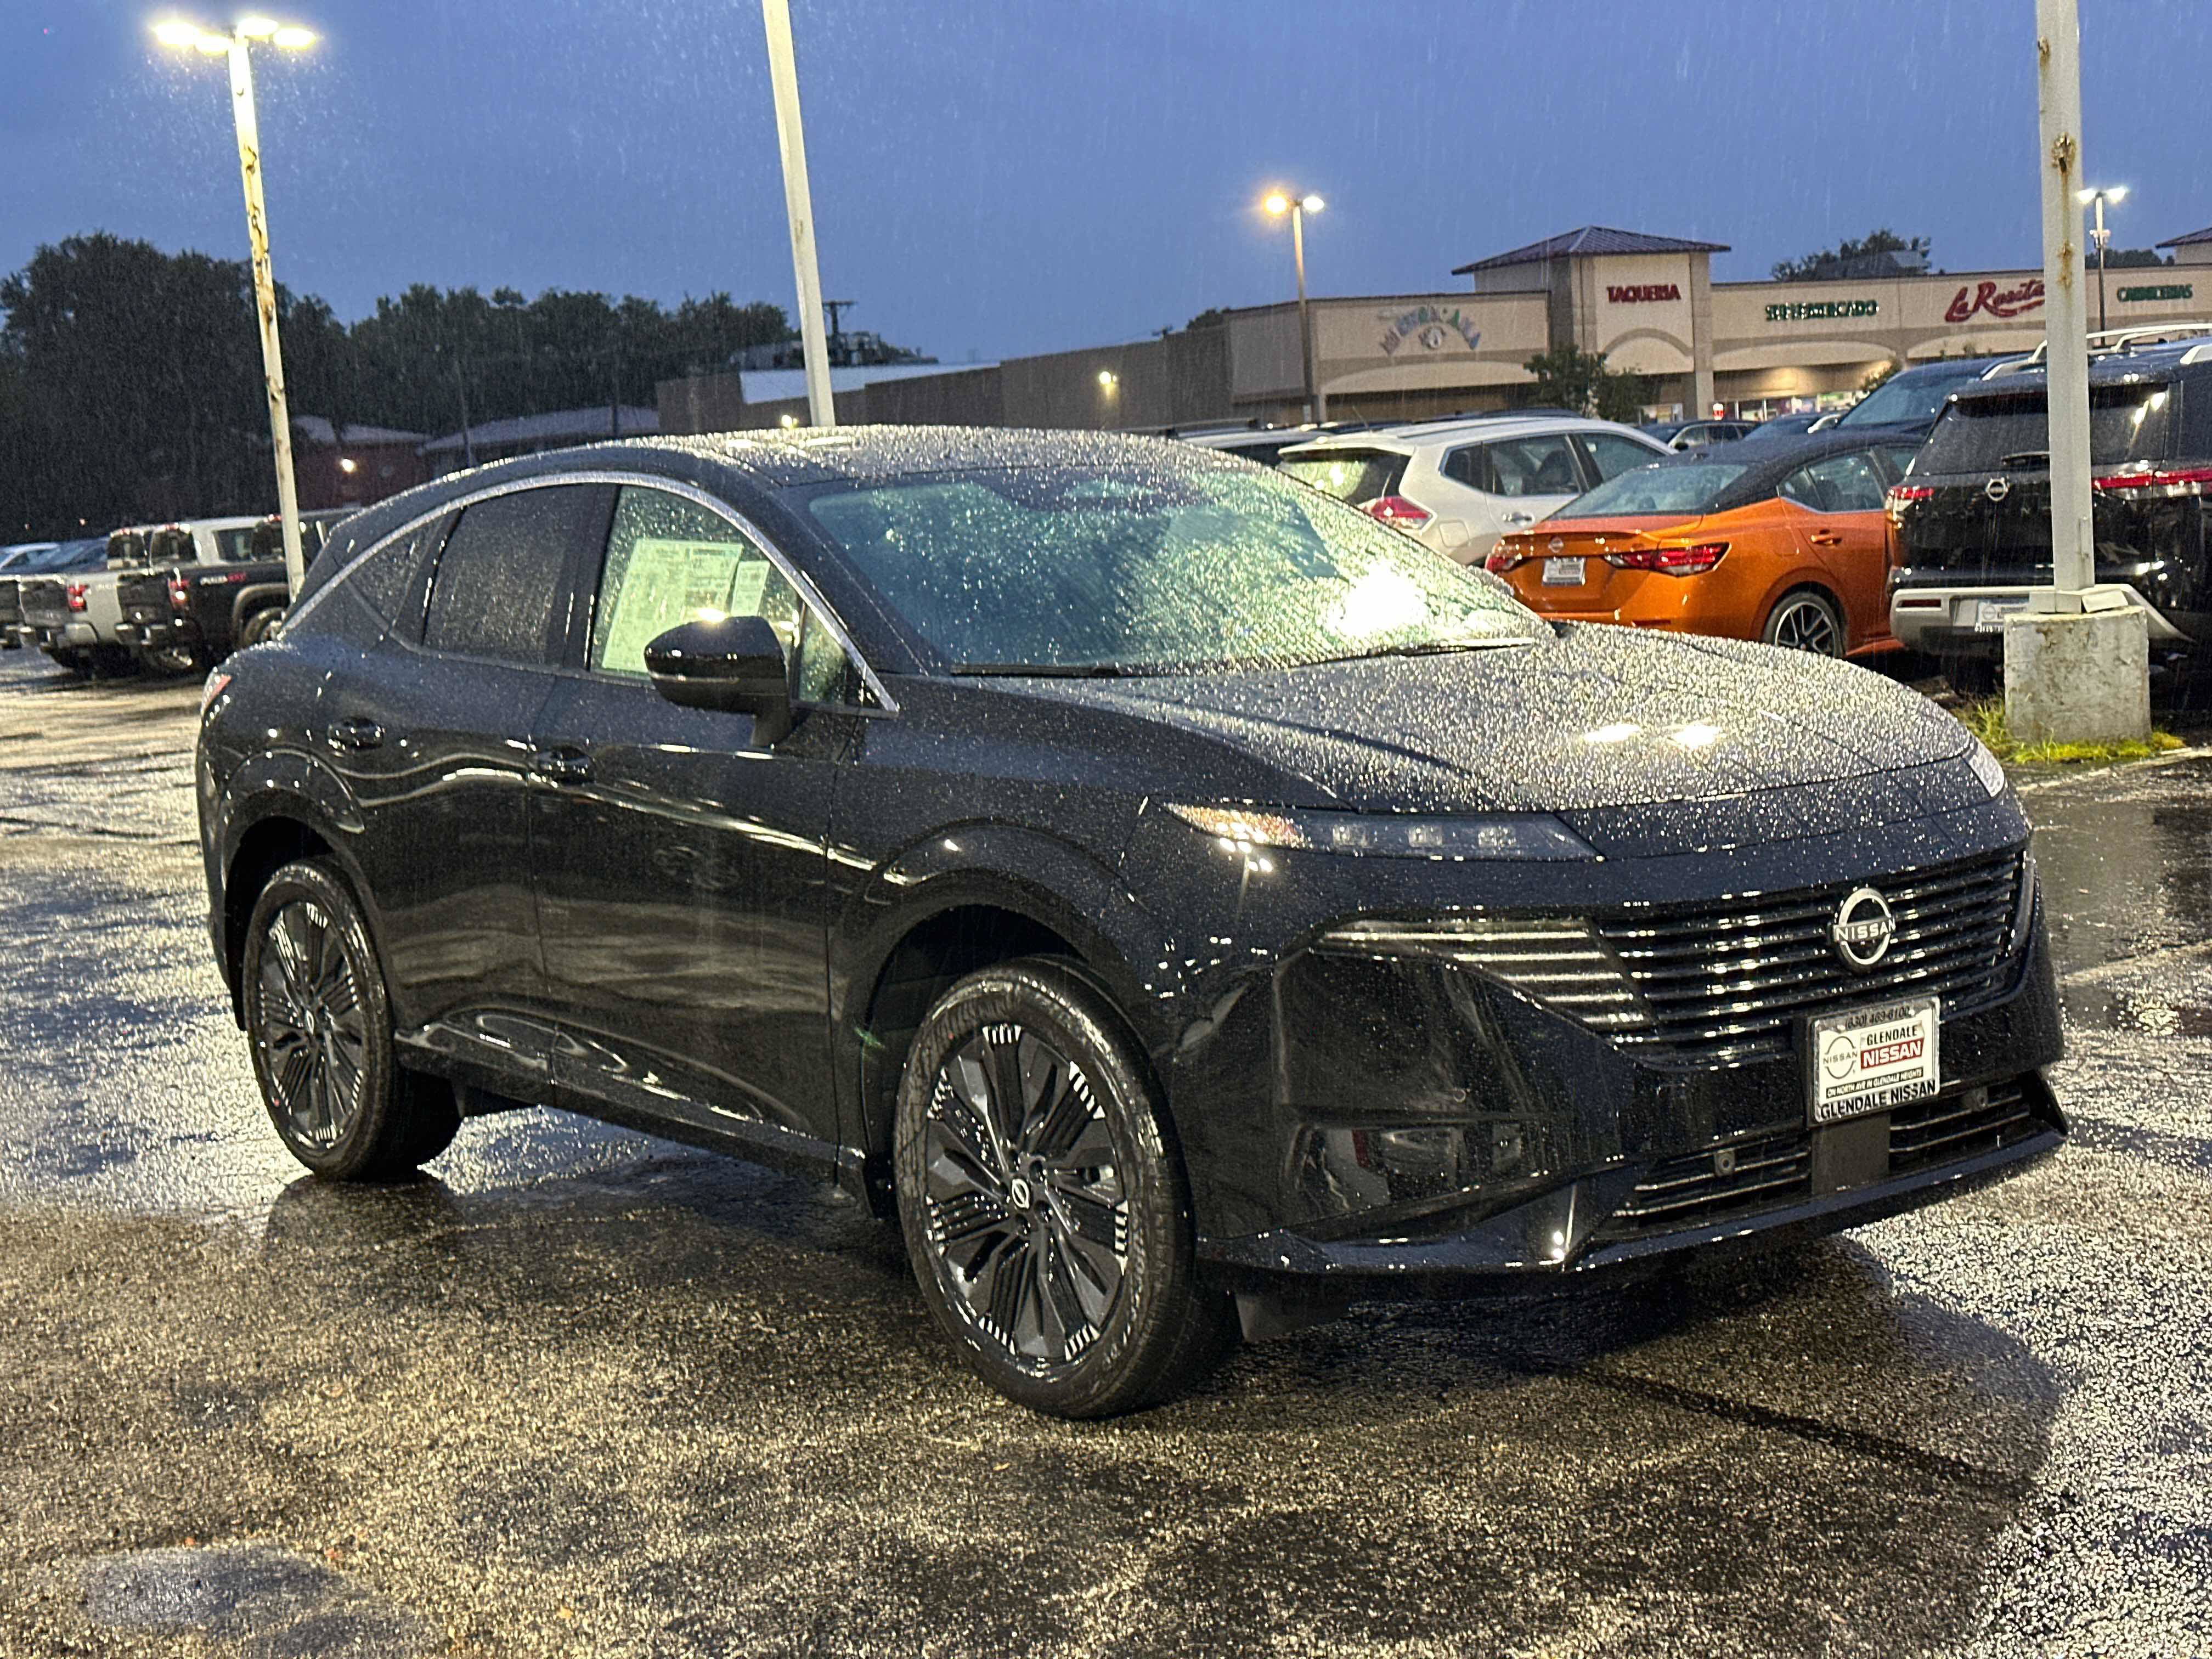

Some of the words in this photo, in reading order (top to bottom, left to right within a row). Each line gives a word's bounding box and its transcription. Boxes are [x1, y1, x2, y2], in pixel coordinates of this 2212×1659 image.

[1606, 284, 1681, 304] TAQUERIA
[1971, 276, 2046, 318] Rosita
[1836, 917, 1896, 941] NISSAN
[1866, 1024, 1918, 1046] GLENDALE
[1823, 1050, 1858, 1065] NISSAN
[1863, 1041, 1921, 1067] NISSAN
[1827, 1088, 1836, 1097] ON
[1837, 1084, 1854, 1095] NORTH
[1855, 1081, 1866, 1091] AVE
[1866, 1079, 1872, 1088] IN
[1873, 1073, 1900, 1086] GLENDALE
[1900, 1068, 1922, 1080] HEIGHTS
[1820, 1091, 1887, 1119] GLENDALE
[1891, 1079, 1936, 1103] NISSAN
